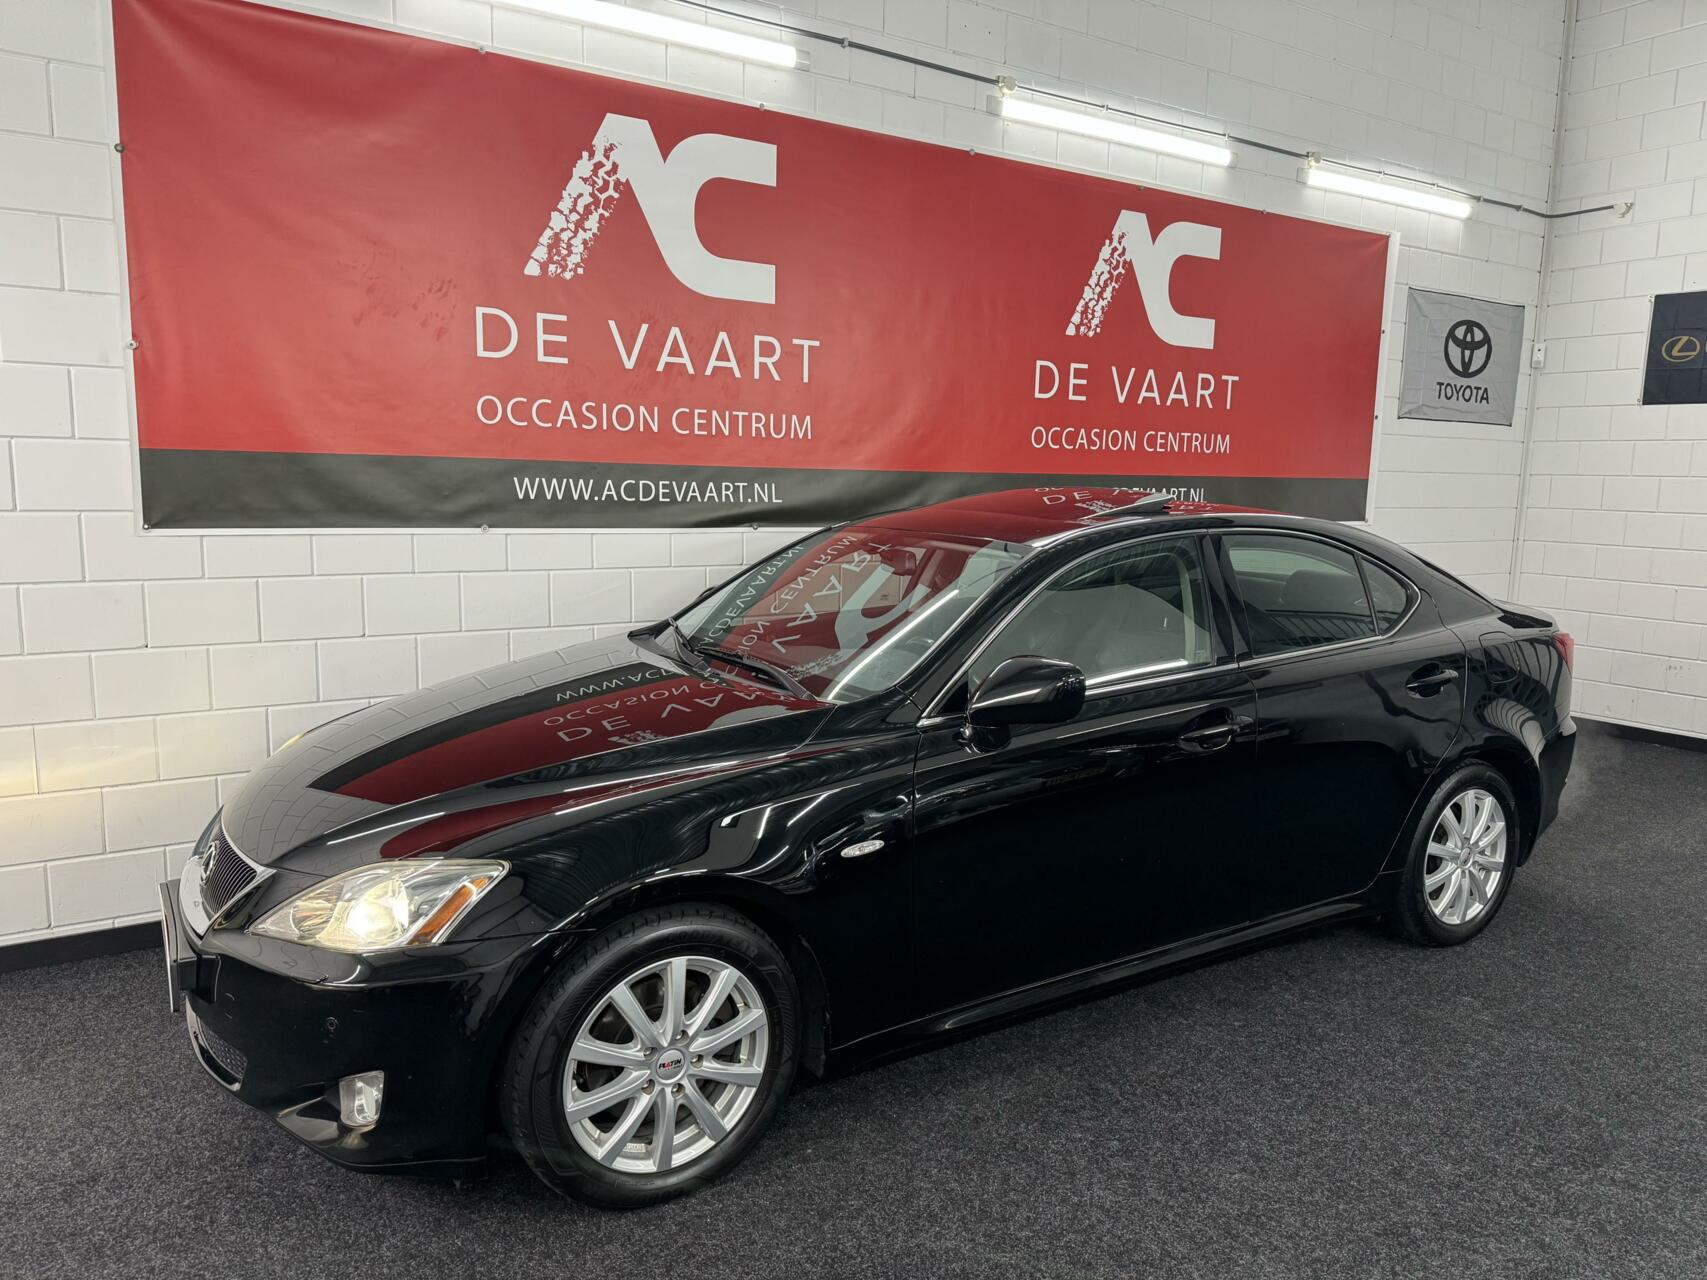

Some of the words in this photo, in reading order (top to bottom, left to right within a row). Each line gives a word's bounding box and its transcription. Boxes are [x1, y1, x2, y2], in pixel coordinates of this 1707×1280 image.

[524, 113, 777, 304] AC
[1066, 210, 1221, 349] AC
[476, 307, 568, 363] DE
[608, 320, 820, 383] VAART
[1034, 360, 1088, 400] DE
[1111, 366, 1239, 409] VAART
[1436, 382, 1489, 404] TOYOTA
[476, 395, 658, 432] OCCASION
[672, 408, 812, 439] CENTRUM
[1031, 426, 1136, 451] OCCASION
[1143, 431, 1230, 453] CENTRUM
[513, 477, 783, 503] WWW.ACDEVAART.NL
